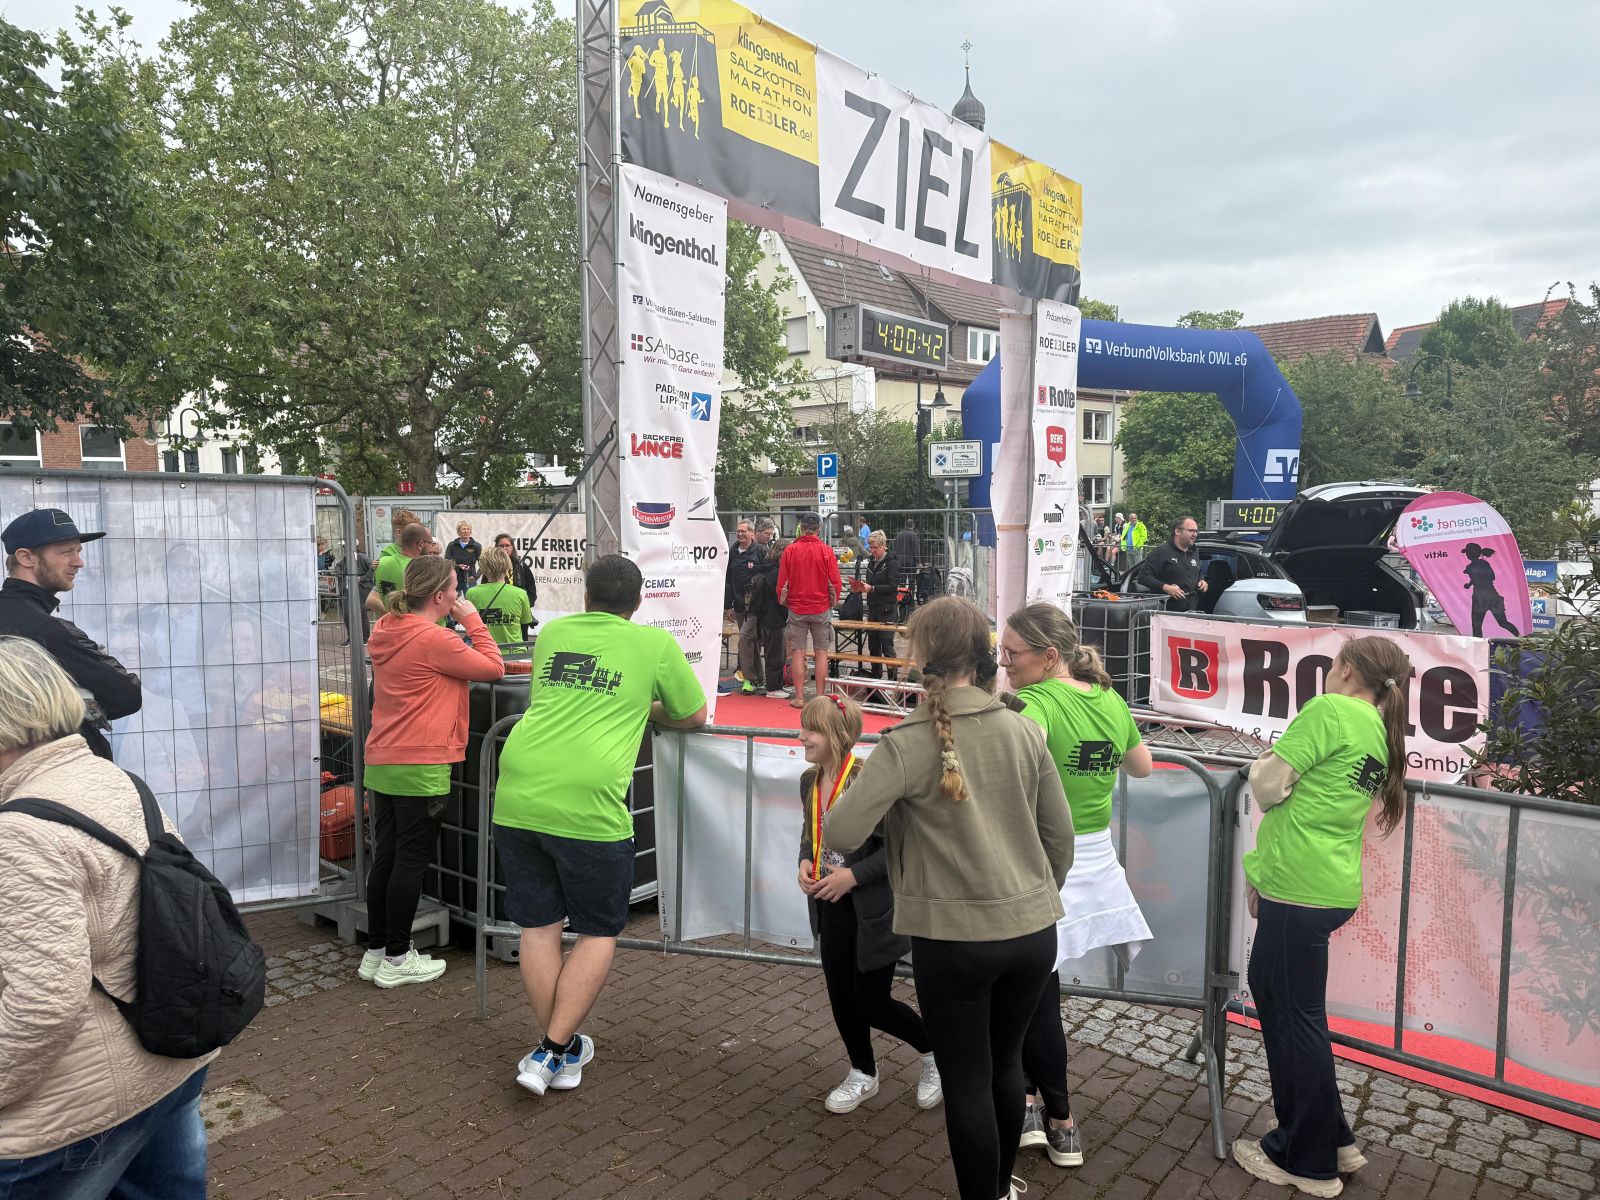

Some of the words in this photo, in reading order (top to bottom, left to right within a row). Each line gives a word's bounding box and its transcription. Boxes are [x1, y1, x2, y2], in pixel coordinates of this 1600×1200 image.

[738, 25, 802, 76] klingenthal.
[730, 51, 811, 101] SALZKOTTEN
[730, 68, 812, 117] MARATHON
[834, 89, 980, 259] ZIEL
[634, 183, 713, 223] Namensgeber
[629, 212, 719, 266] klingenthal.
[878, 321, 943, 360] 4:00:42
[1105, 339, 1206, 364] VerbundVolksbank
[1208, 350, 1232, 365] OWL
[1234, 352, 1248, 366] eG
[631, 432, 685, 460] LANGE
[821, 456, 833, 475] P
[541, 538, 586, 552] ERREIC
[671, 541, 718, 565] lean-pro
[550, 553, 583, 570] ERFÜ
[1524, 567, 1547, 578] álaga
[553, 576, 572, 584] ALLEN
[645, 578, 676, 589] CEMEX
[644, 591, 680, 599] ADMIXTURES
[575, 684, 592, 692] immer
